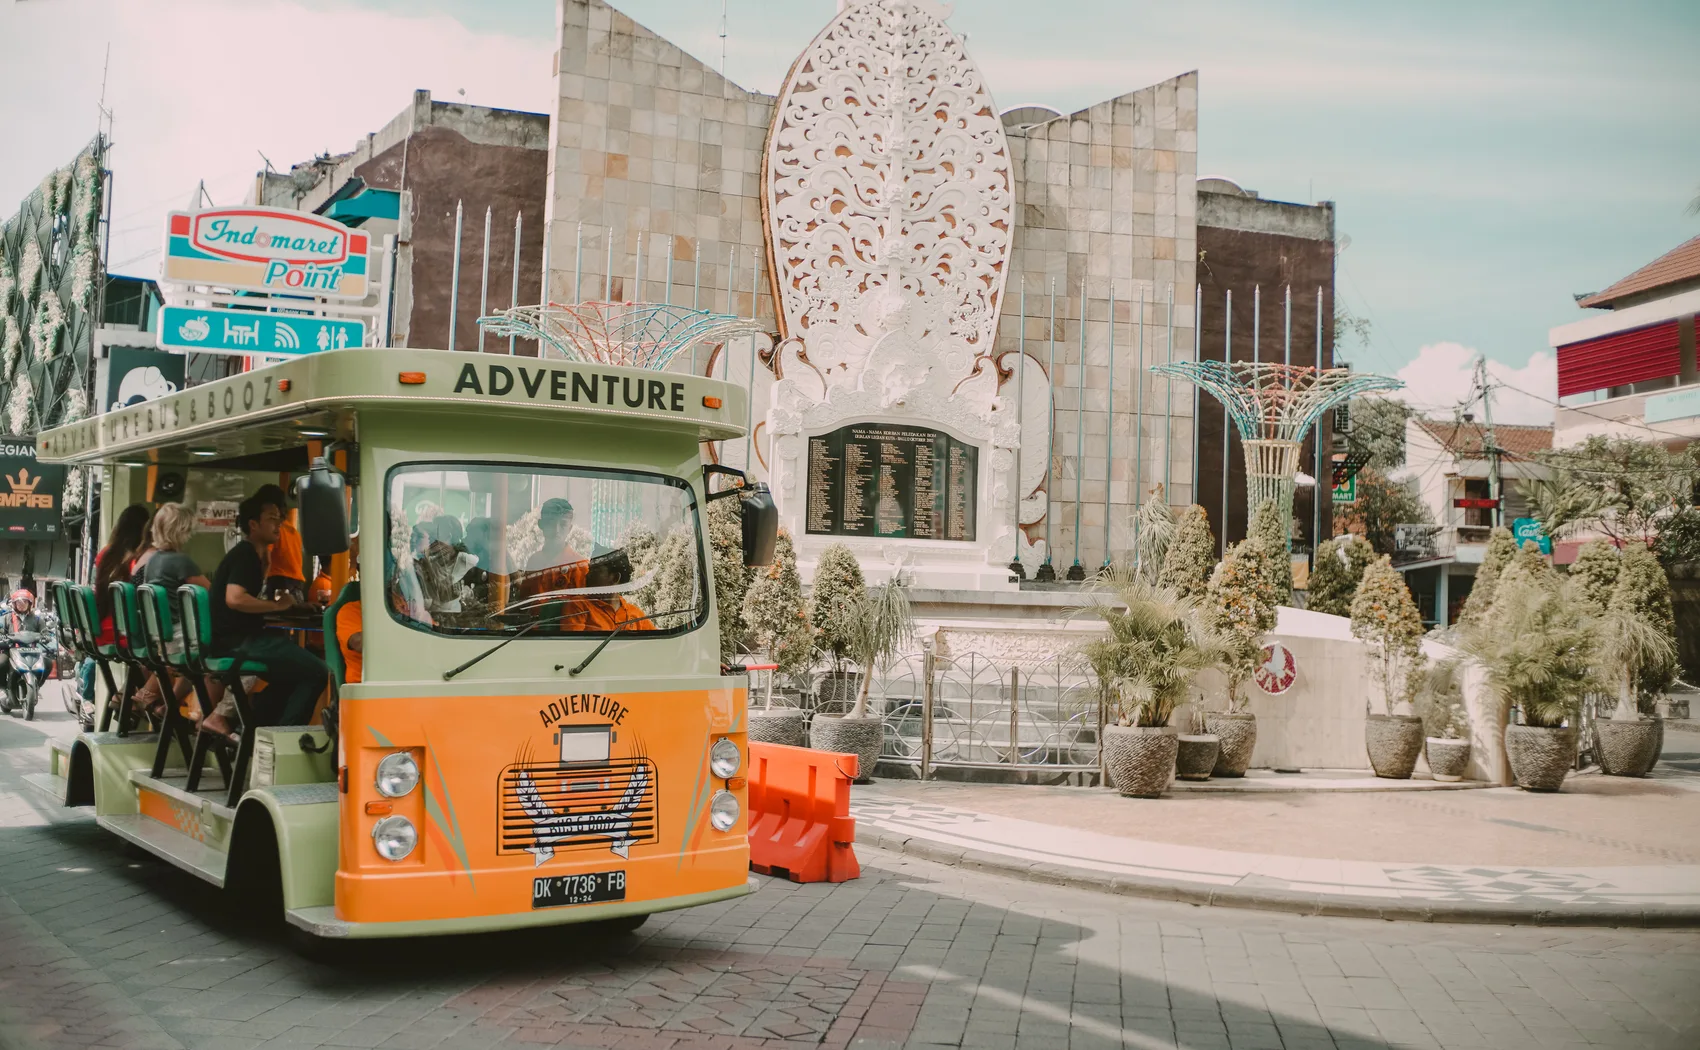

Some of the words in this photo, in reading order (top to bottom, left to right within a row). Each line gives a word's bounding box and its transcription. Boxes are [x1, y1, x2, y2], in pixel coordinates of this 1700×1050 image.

[204, 219, 339, 254] Indomaret
[265, 261, 343, 290] Point
[453, 362, 684, 411] ADVENTURE
[52, 412, 139, 456] ADVENURE
[208, 376, 273, 418] BOOZ
[1332, 492, 1352, 500] MART
[1254, 667, 1295, 691] BALI
[539, 693, 629, 728] ADVENTURE
[534, 879, 551, 898] DK
[563, 875, 596, 895] 7736
[607, 872, 625, 891] FB
